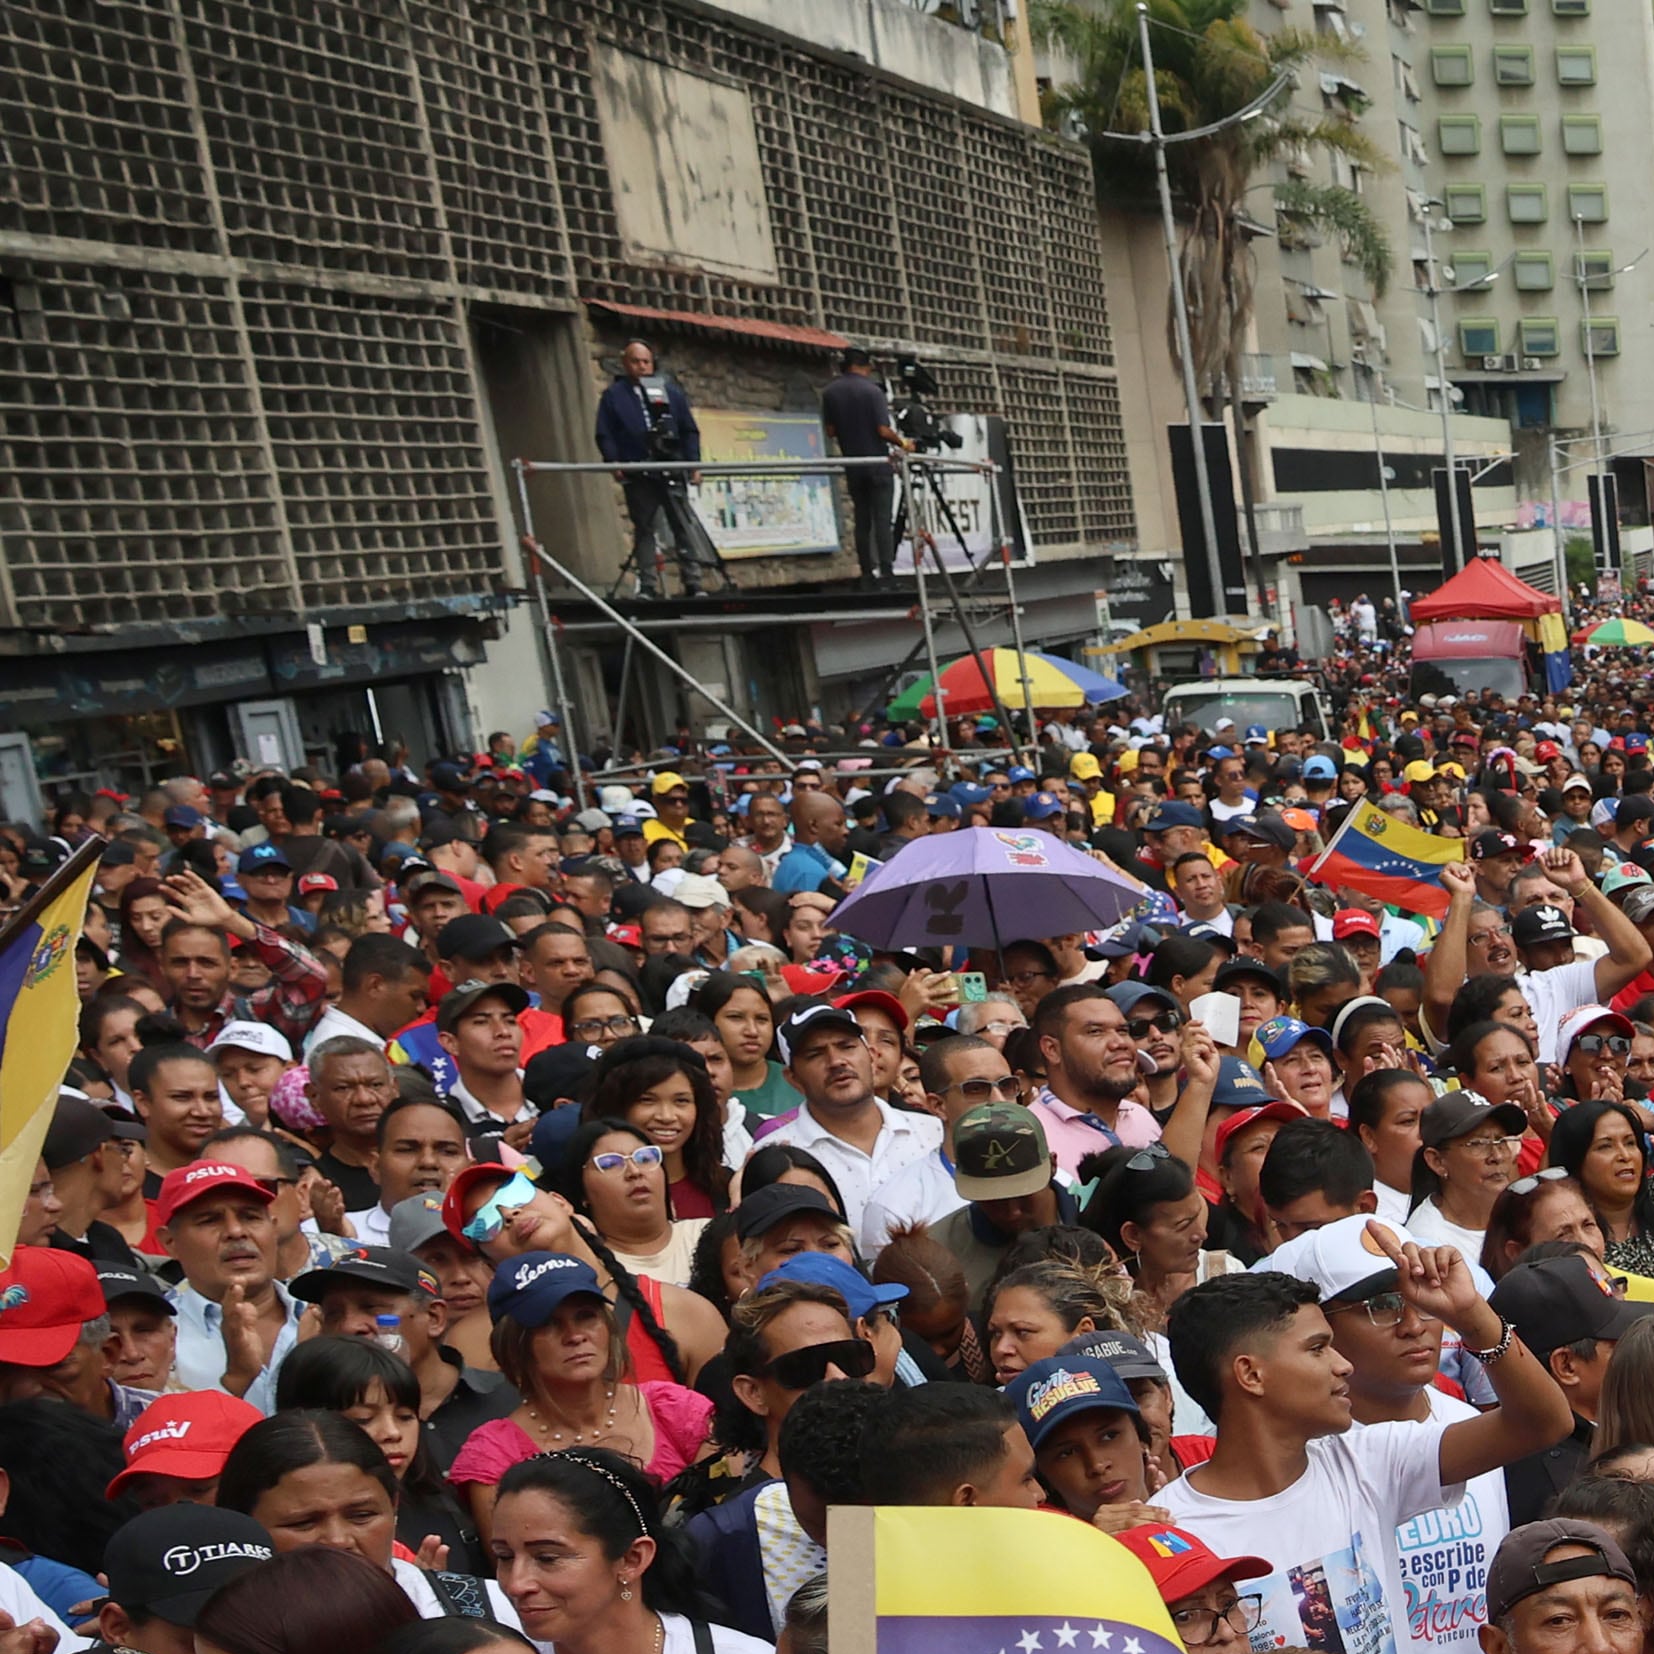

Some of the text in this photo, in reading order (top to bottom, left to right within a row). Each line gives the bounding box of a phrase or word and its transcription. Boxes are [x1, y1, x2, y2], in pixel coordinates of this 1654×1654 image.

[186, 1164, 238, 1183] PSUV
[1030, 1377, 1102, 1423] RESUELVE
[128, 1419, 193, 1456] PSUV
[1411, 1541, 1487, 1577] escribe
[1422, 1558, 1488, 1594] con P de
[1436, 1626, 1478, 1646] CIRCUIT
